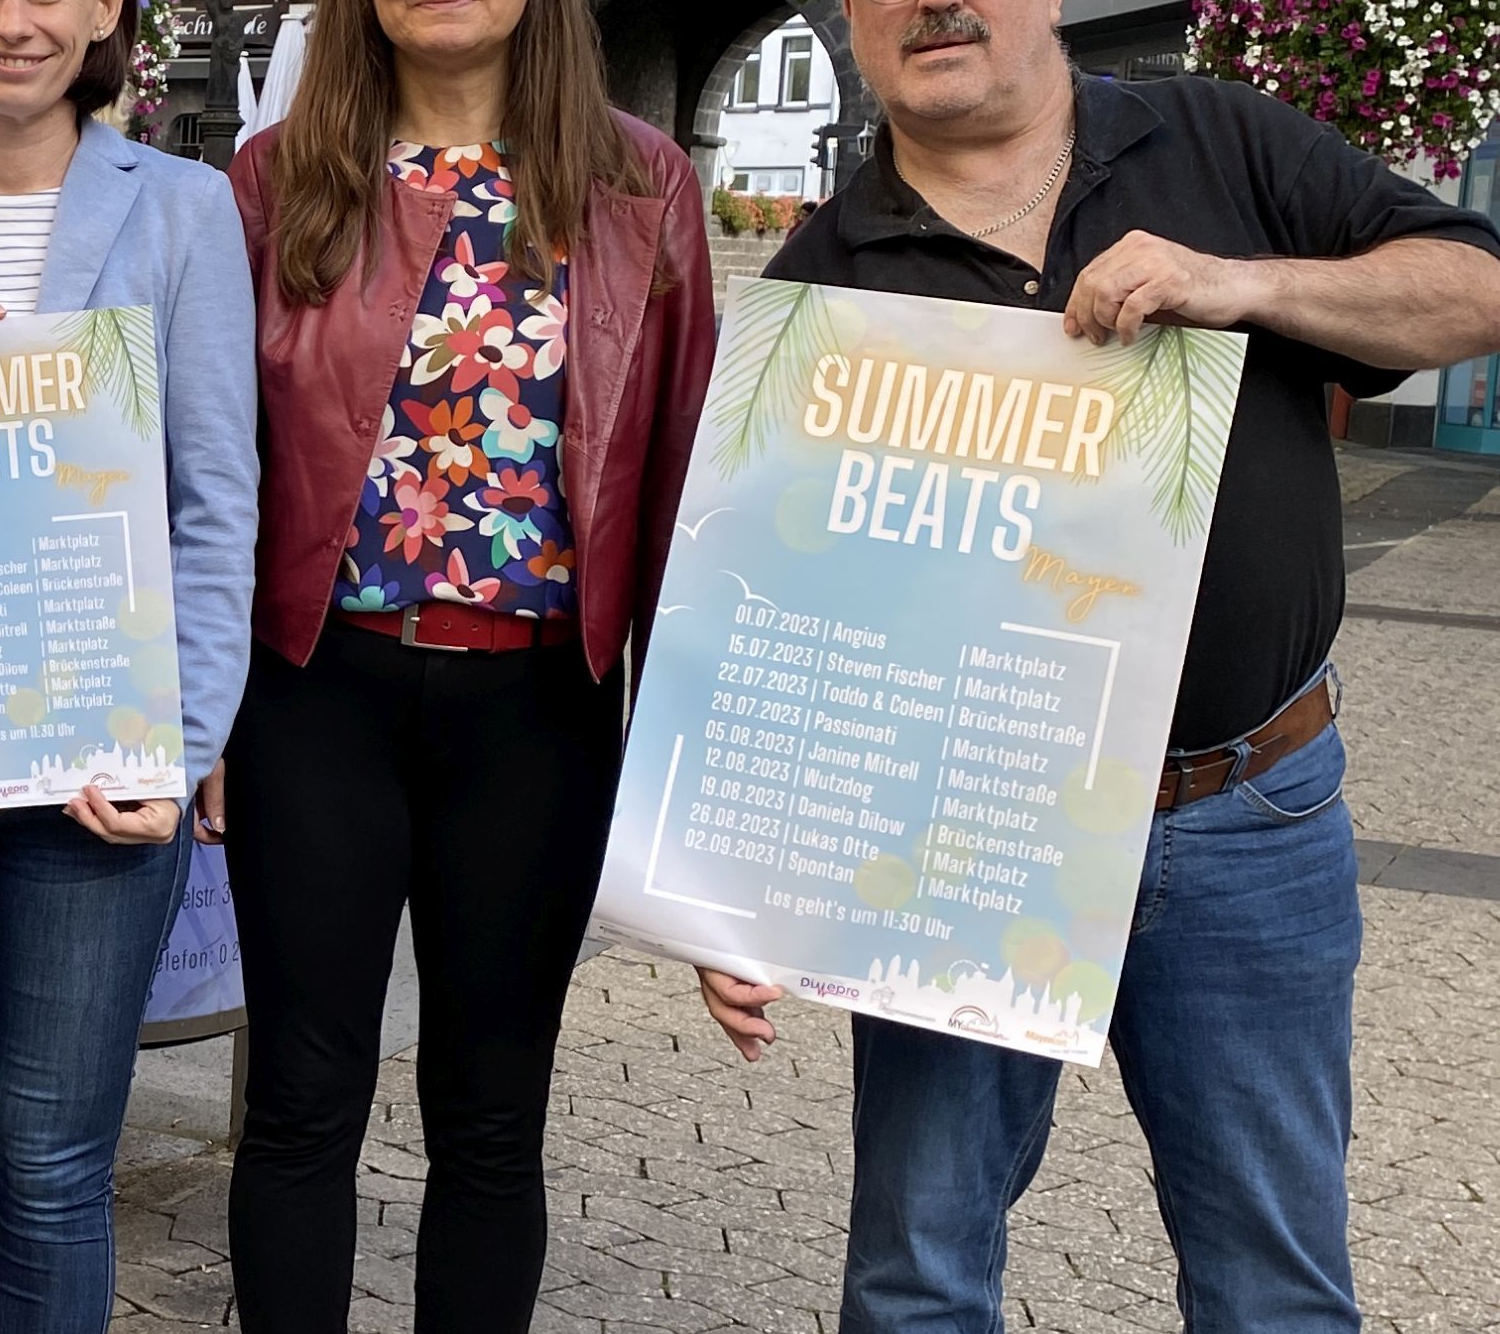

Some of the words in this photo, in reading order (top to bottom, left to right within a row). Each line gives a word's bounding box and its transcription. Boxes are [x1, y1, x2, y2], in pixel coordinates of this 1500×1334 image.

[804, 354, 1117, 475] SUMMER
[38, 534, 100, 551] Marktplatz
[827, 449, 1042, 561] BEATS
[40, 555, 101, 572] Marktplatz
[1024, 545, 1140, 621] Mayen
[43, 596, 105, 613] Marktplatz
[734, 604, 820, 636] 01.07.2023
[832, 622, 886, 649] Angius
[969, 647, 1066, 680] Marktplatz
[47, 637, 108, 654] Marktplatz
[728, 634, 813, 666] 15.07.2023
[826, 652, 881, 679] Steven
[885, 663, 945, 691] Fischer
[964, 677, 1061, 712] Marktplatz
[50, 674, 111, 694] Marktplatz
[52, 693, 113, 709] Marktplatz
[718, 662, 808, 695] 22.07.2023
[822, 681, 868, 707] Toddo
[872, 691, 883, 710] &
[889, 694, 944, 722] Coleen
[958, 707, 1086, 747] Brückenstraße
[9, 729, 27, 740] um
[57, 723, 75, 736] Uhr
[704, 720, 795, 755] 05.08.2023
[807, 741, 860, 768] Janine
[864, 752, 919, 780] Mitrell
[947, 768, 1057, 806] Marktstraße
[711, 691, 801, 725] 29.07.2023
[814, 711, 897, 745] Passionati
[952, 738, 1049, 773] Marktplatz
[700, 775, 785, 810] 19.08.2023
[797, 796, 854, 826] Daniela
[858, 809, 905, 835] Dilow
[936, 825, 1064, 866] Brückenstraße
[705, 747, 790, 781] 12.08.2023
[803, 767, 873, 803] Wutzdog
[942, 797, 1038, 832] Marktplatz
[684, 829, 775, 864] 02.09.2023
[787, 851, 854, 883] Spontan
[927, 877, 1022, 914] Marktplatz
[689, 803, 780, 838] 26.08.2023
[792, 825, 838, 851] Lukas
[842, 836, 879, 861] Otte
[932, 851, 1028, 887] Marktplatz
[182, 886, 216, 910] elstr.
[764, 885, 791, 908] Los
[850, 909, 877, 925] um
[924, 917, 953, 940] Uhr
